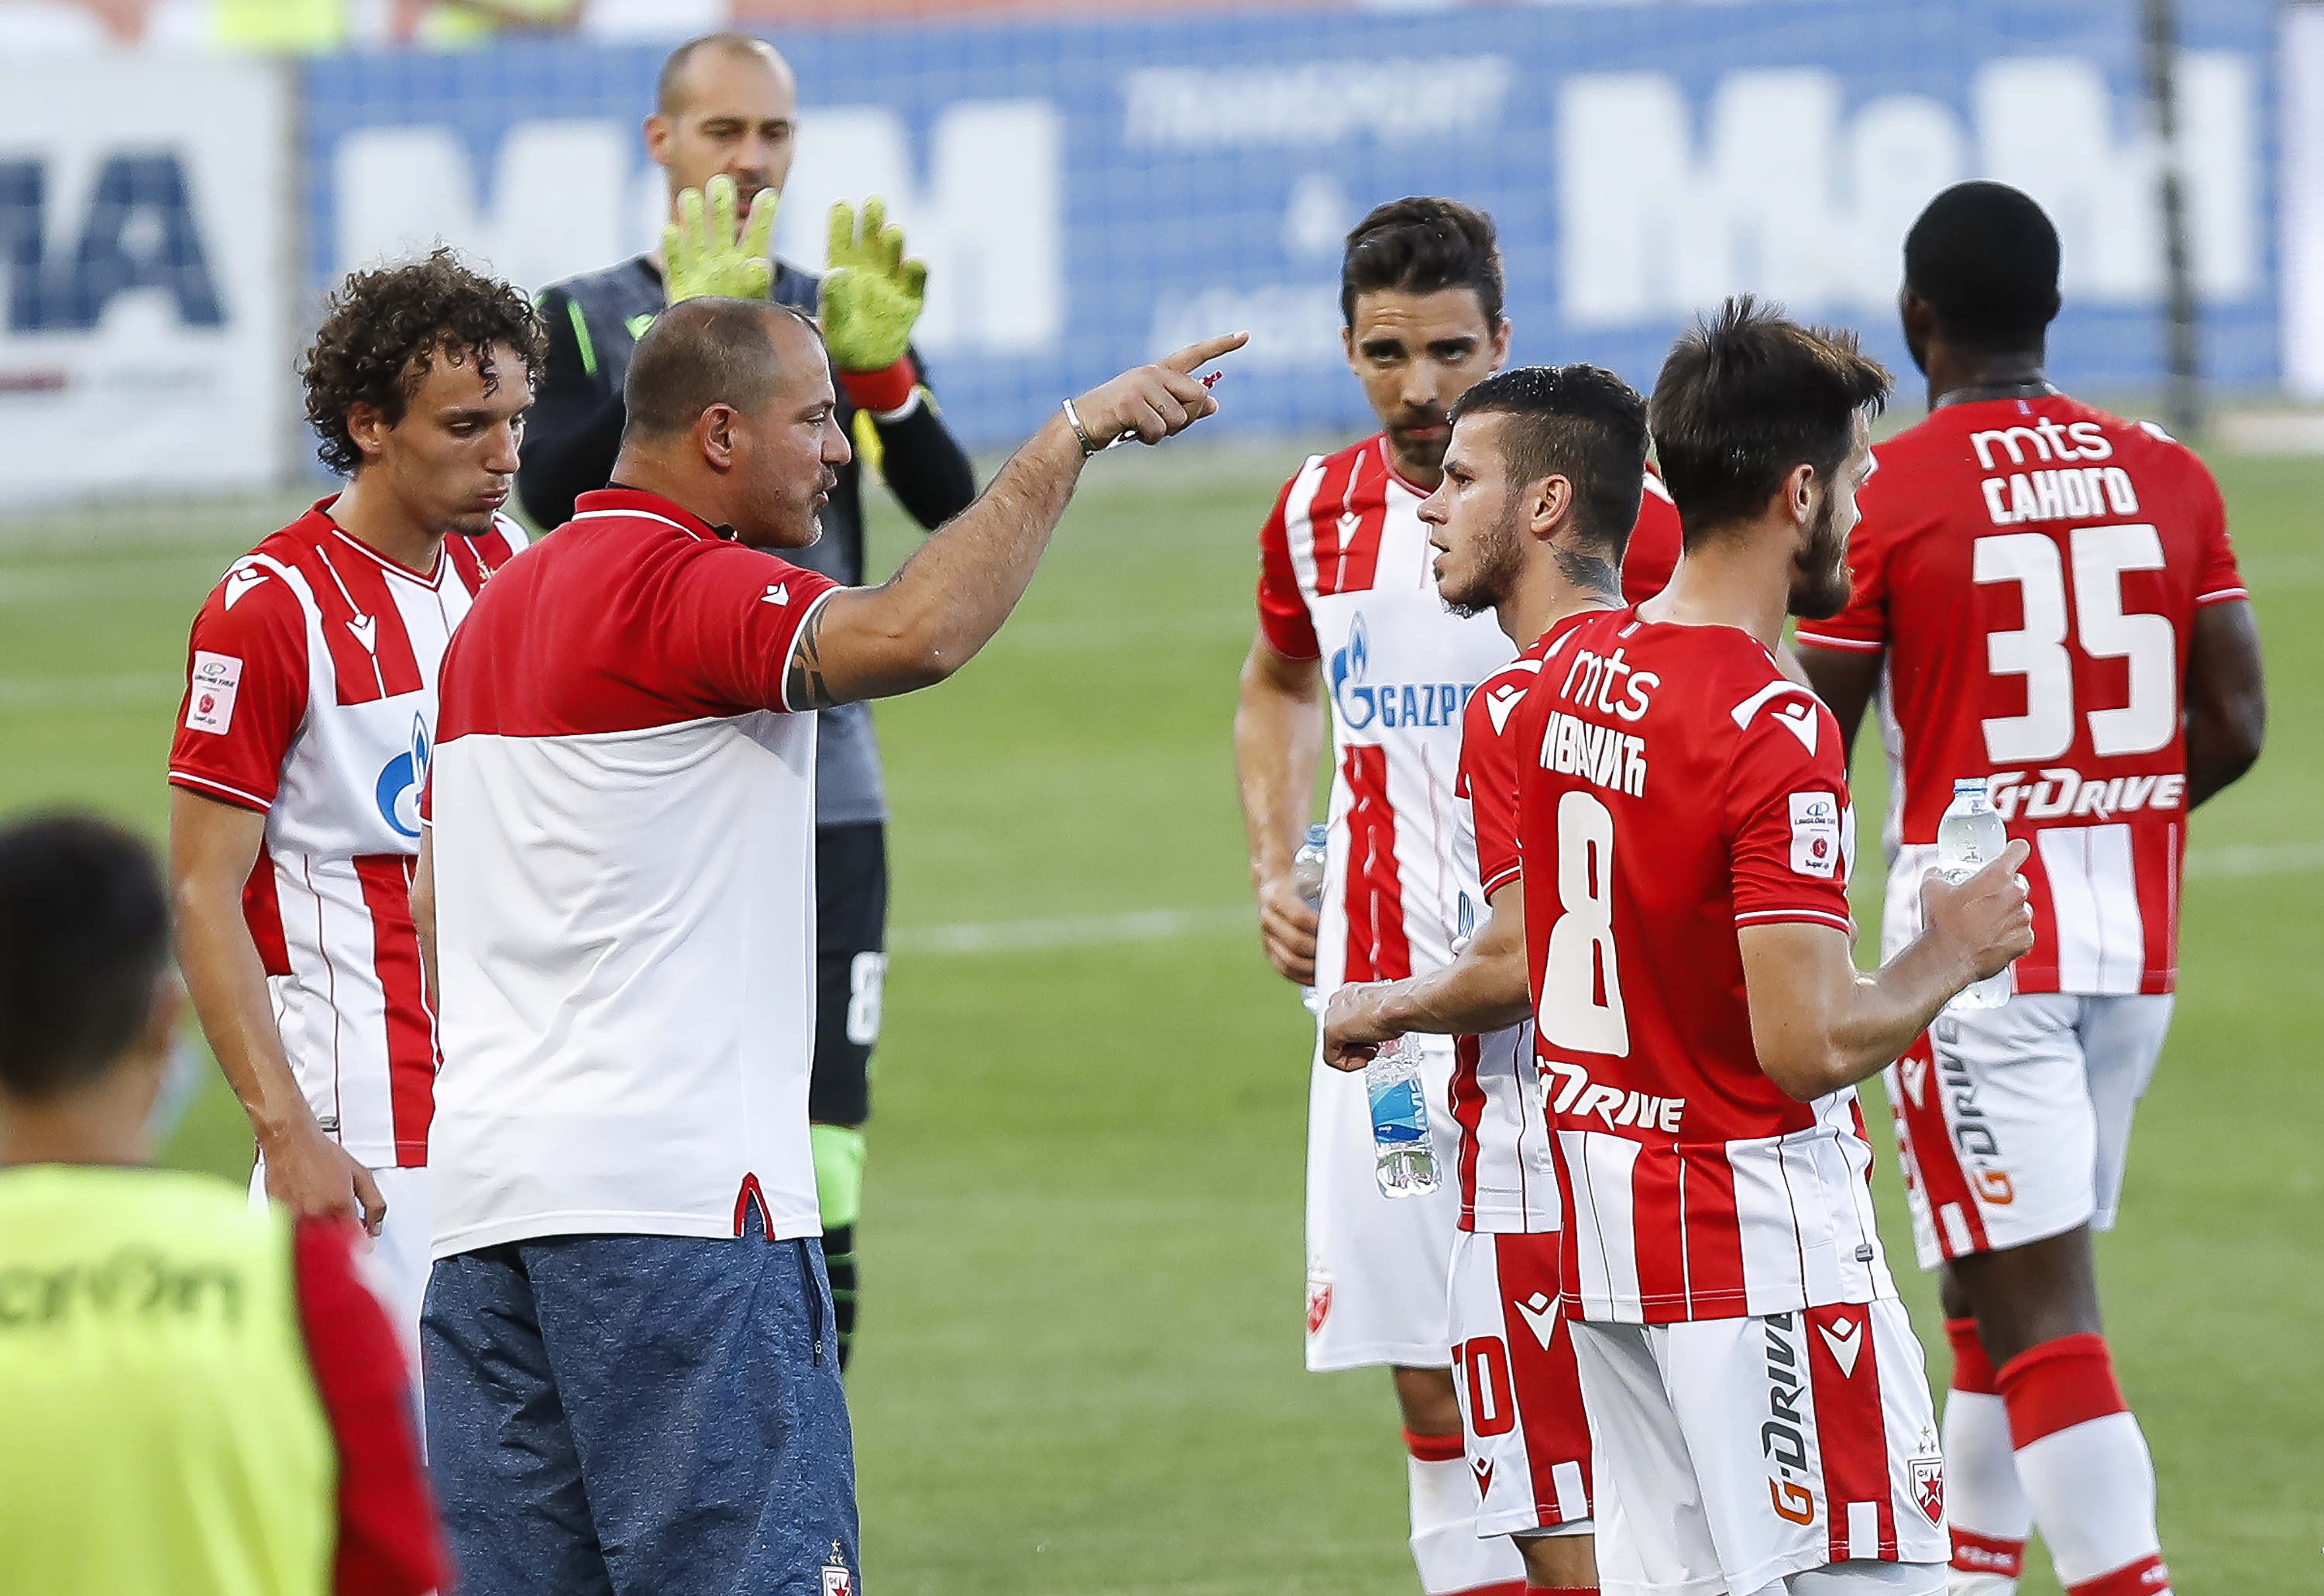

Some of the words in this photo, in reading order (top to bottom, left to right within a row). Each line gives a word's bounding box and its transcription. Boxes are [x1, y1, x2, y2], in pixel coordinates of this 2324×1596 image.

[1969, 416, 2113, 470] mts
[1981, 467, 2140, 525] САНОГО
[1973, 524, 2177, 764] 35
[1560, 648, 1661, 722] mts
[1986, 767, 2186, 821] G-DRIVE
[1538, 790, 1628, 1058] 8
[1537, 1055, 1686, 1133] DRIVE
[1937, 1016, 2014, 1206] G-DRIVE
